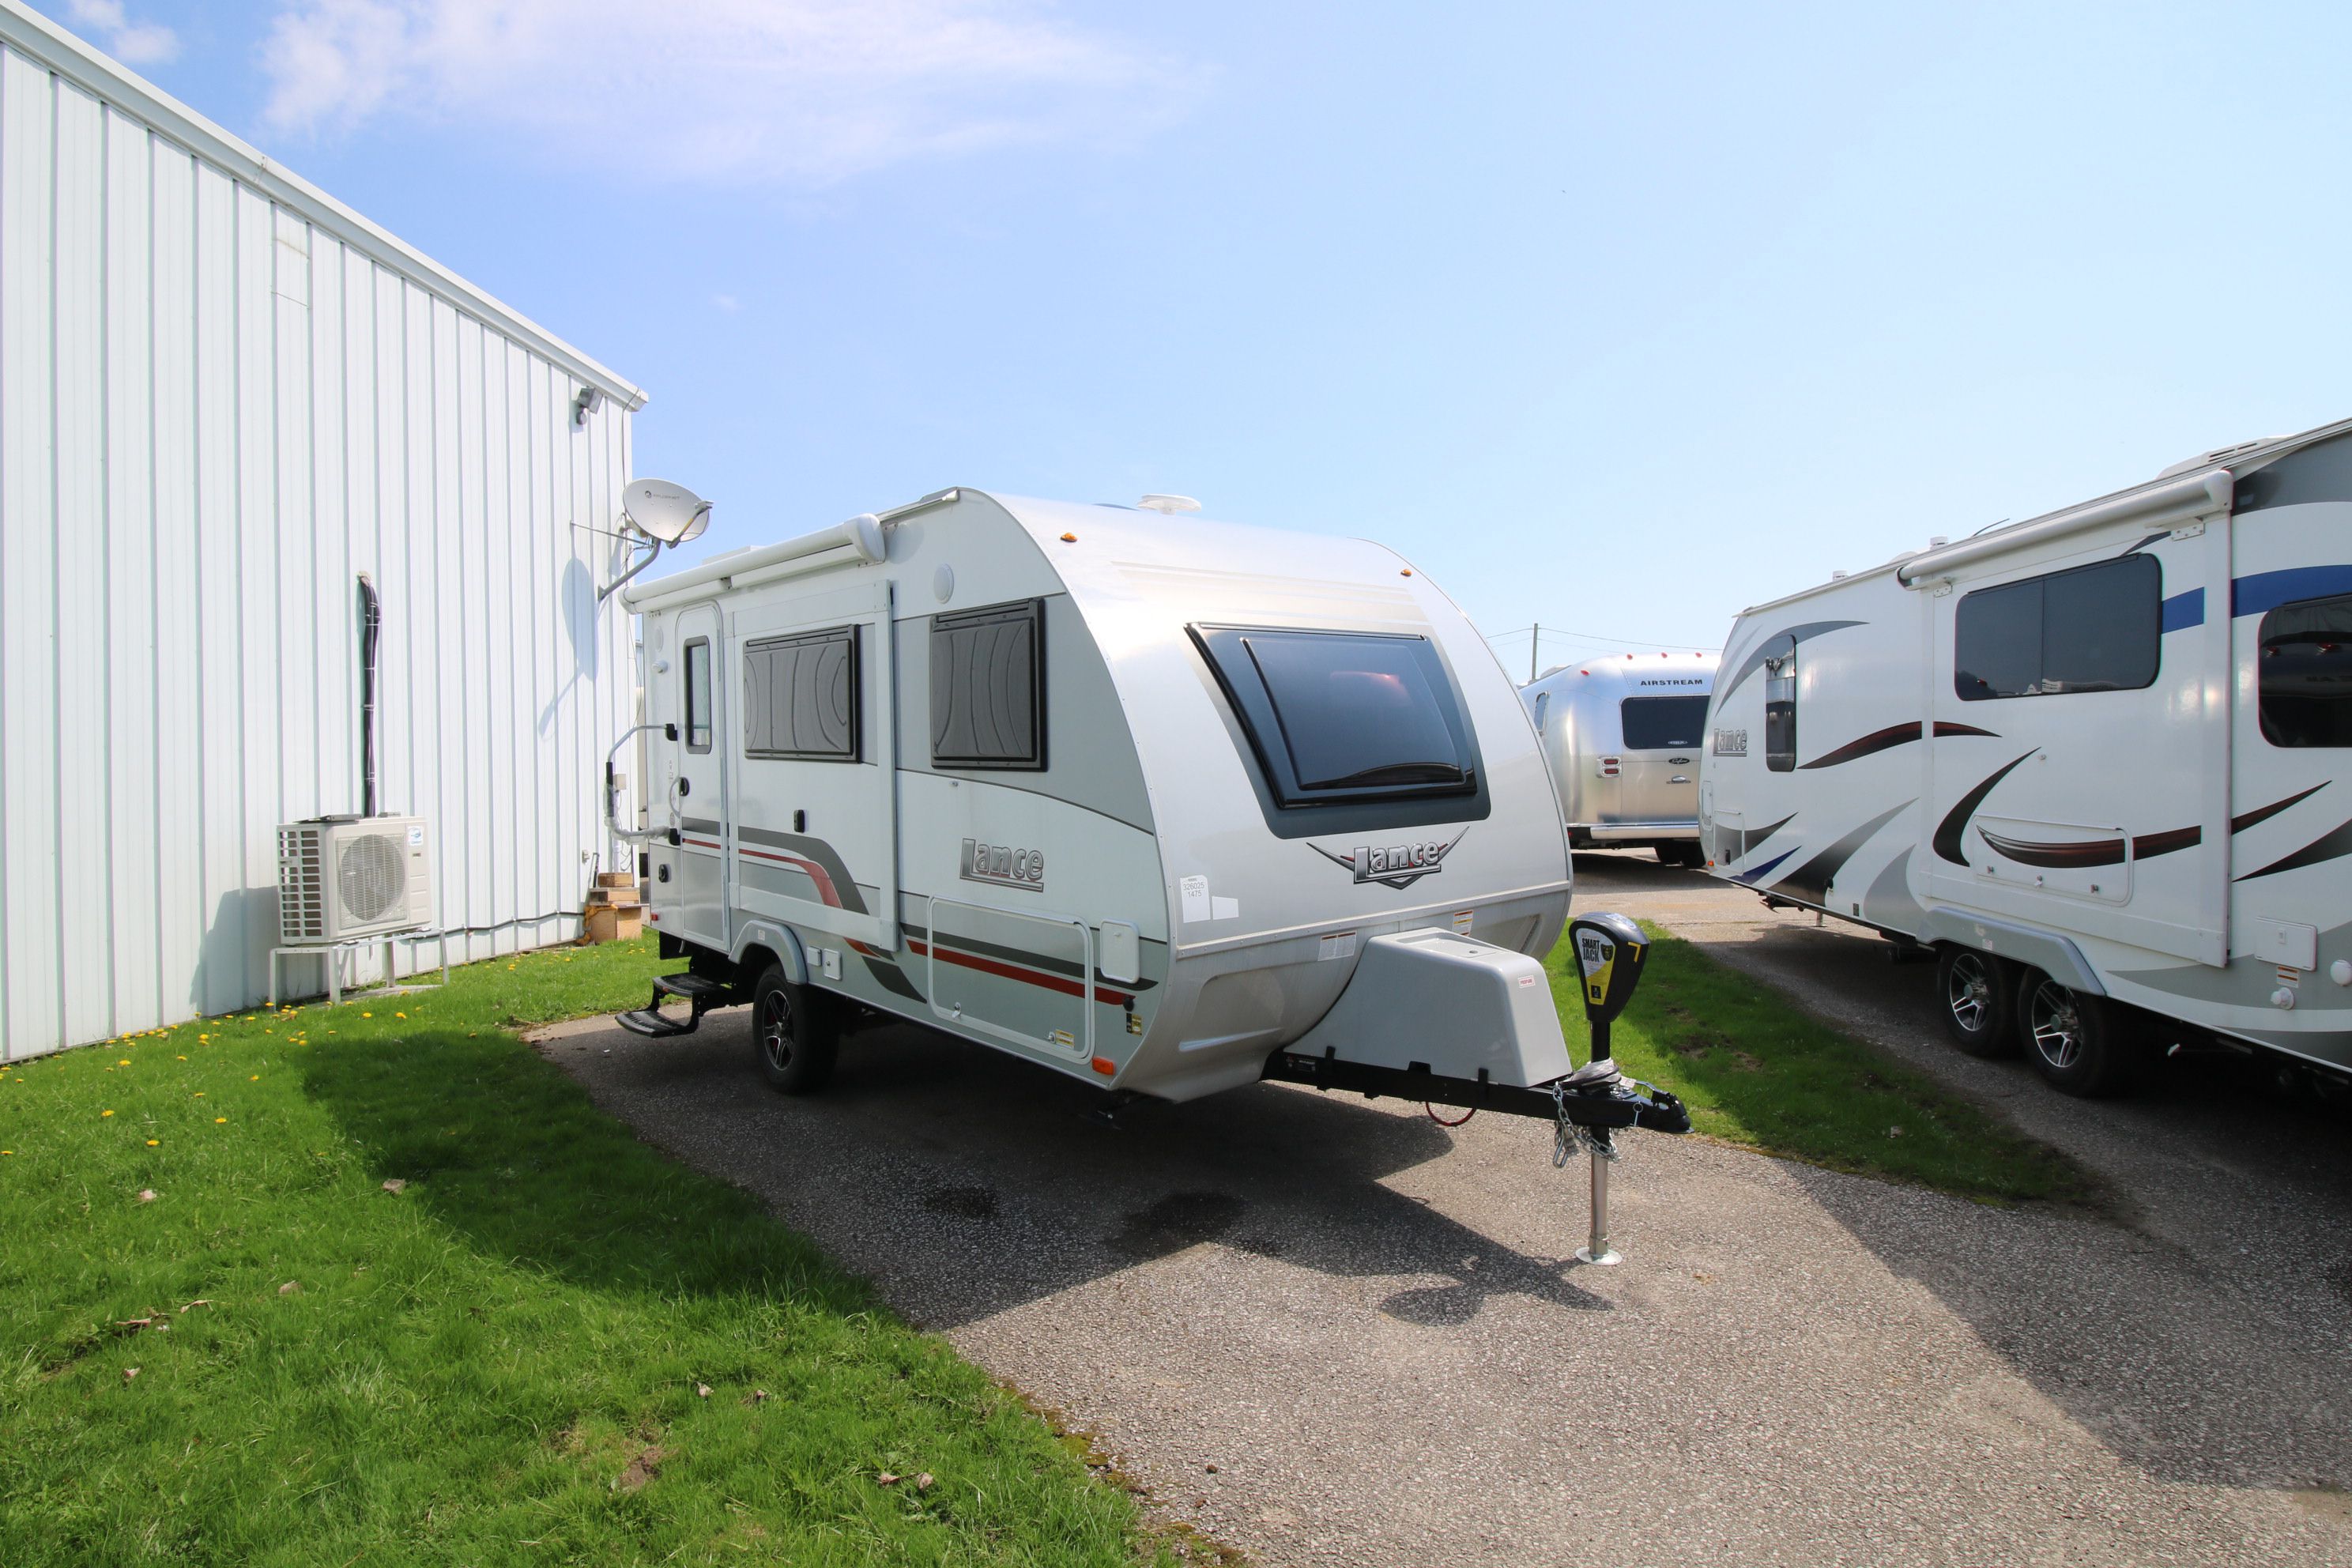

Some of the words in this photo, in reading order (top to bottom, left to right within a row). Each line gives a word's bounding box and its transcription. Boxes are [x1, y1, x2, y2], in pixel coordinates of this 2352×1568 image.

[1713, 728, 1747, 757] Lance
[959, 838, 1044, 893] Lance
[1353, 841, 1442, 885] Lance
[1182, 881, 1205, 891] 326025
[1581, 937, 1600, 950] SMART
[1582, 948, 1600, 963] JACK
